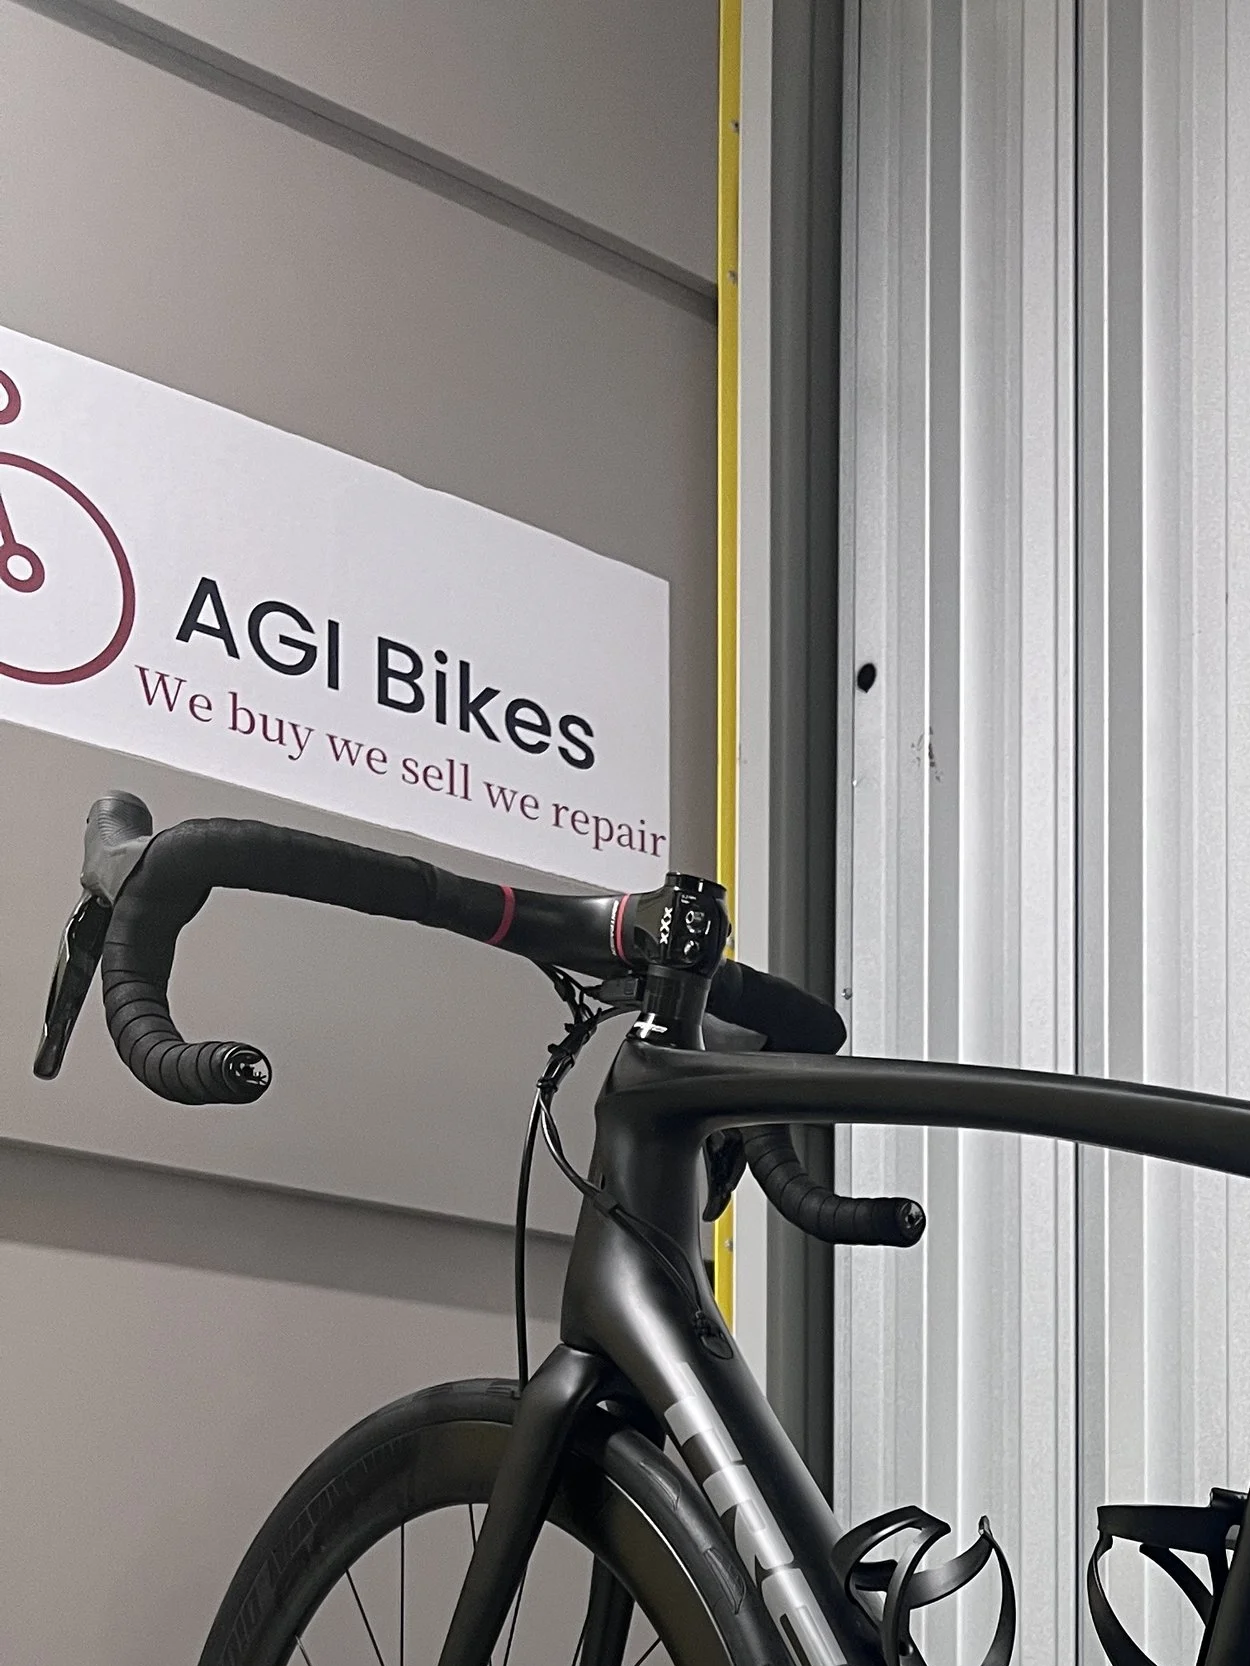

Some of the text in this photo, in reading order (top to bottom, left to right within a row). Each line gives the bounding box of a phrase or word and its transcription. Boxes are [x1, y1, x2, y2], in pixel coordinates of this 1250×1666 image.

[135, 664, 666, 857] We buy we sell we repair
[174, 577, 596, 770] AGI Bikes
